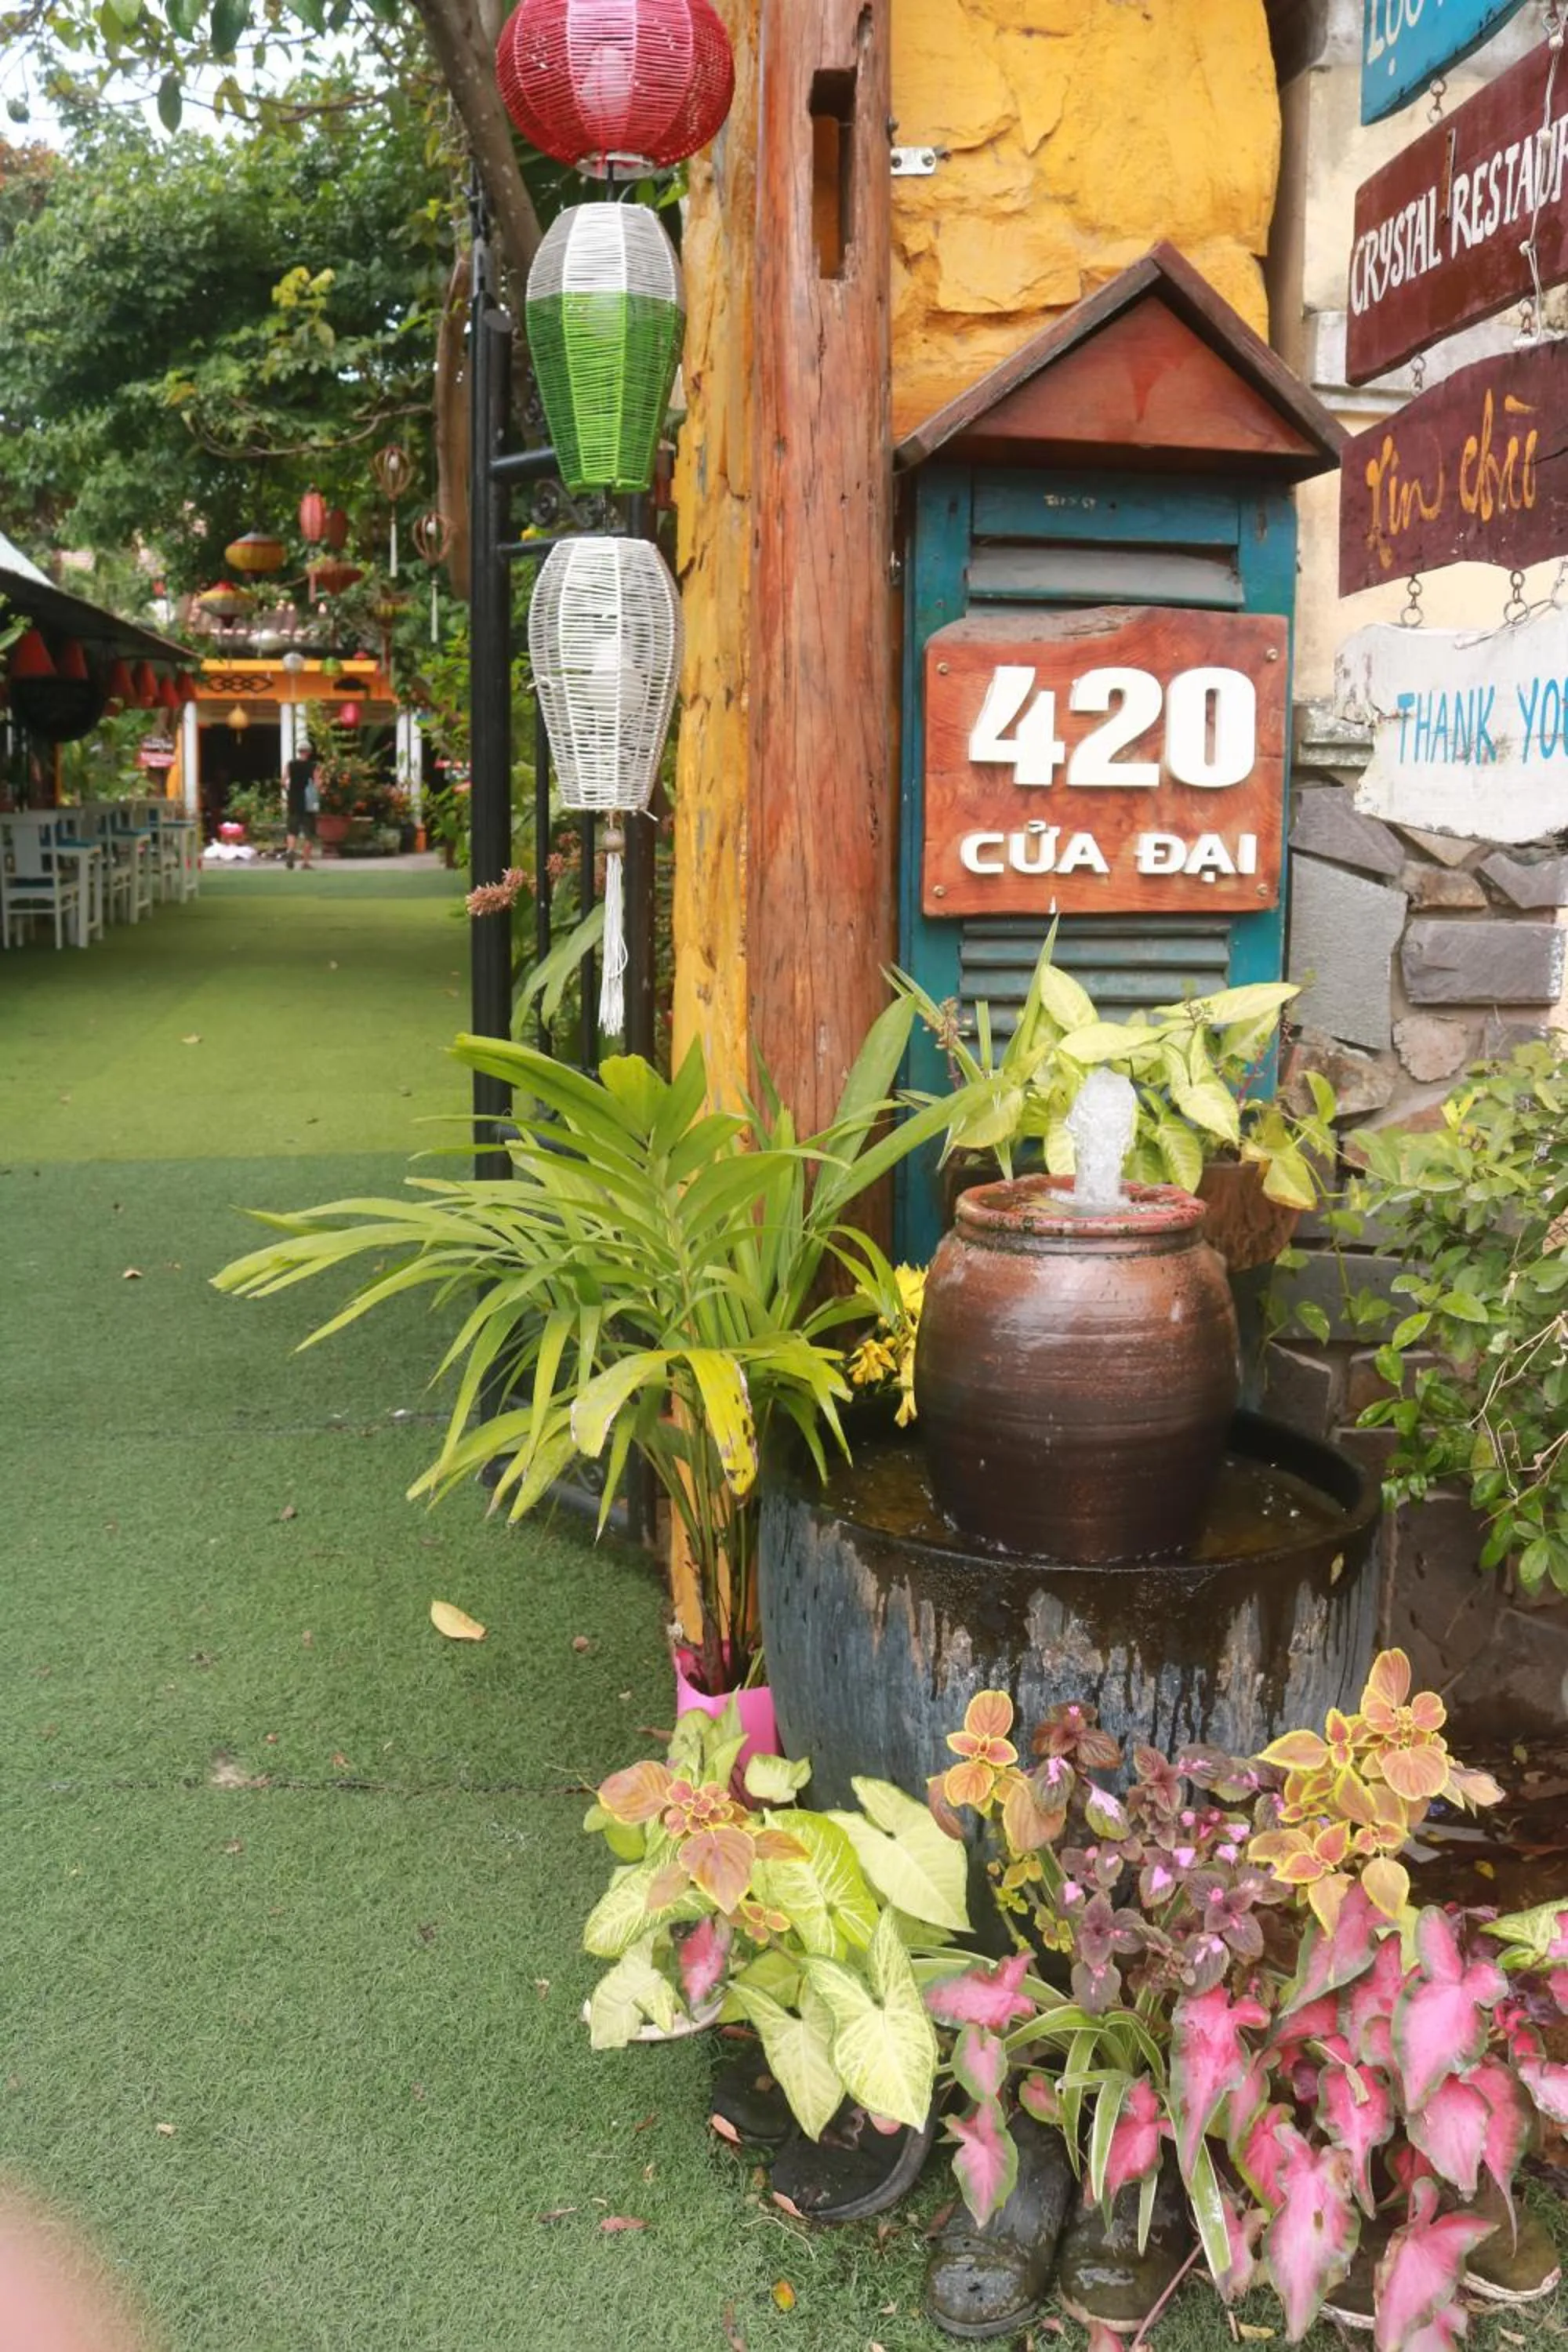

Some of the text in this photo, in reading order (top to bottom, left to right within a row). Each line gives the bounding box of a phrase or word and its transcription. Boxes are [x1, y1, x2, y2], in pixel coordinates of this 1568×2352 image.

[1351, 186, 1443, 316] CRYSTAL
[968, 665, 1257, 787] 420
[1397, 685, 1497, 765] THANK
[1134, 833, 1257, 882] ĐẠI
